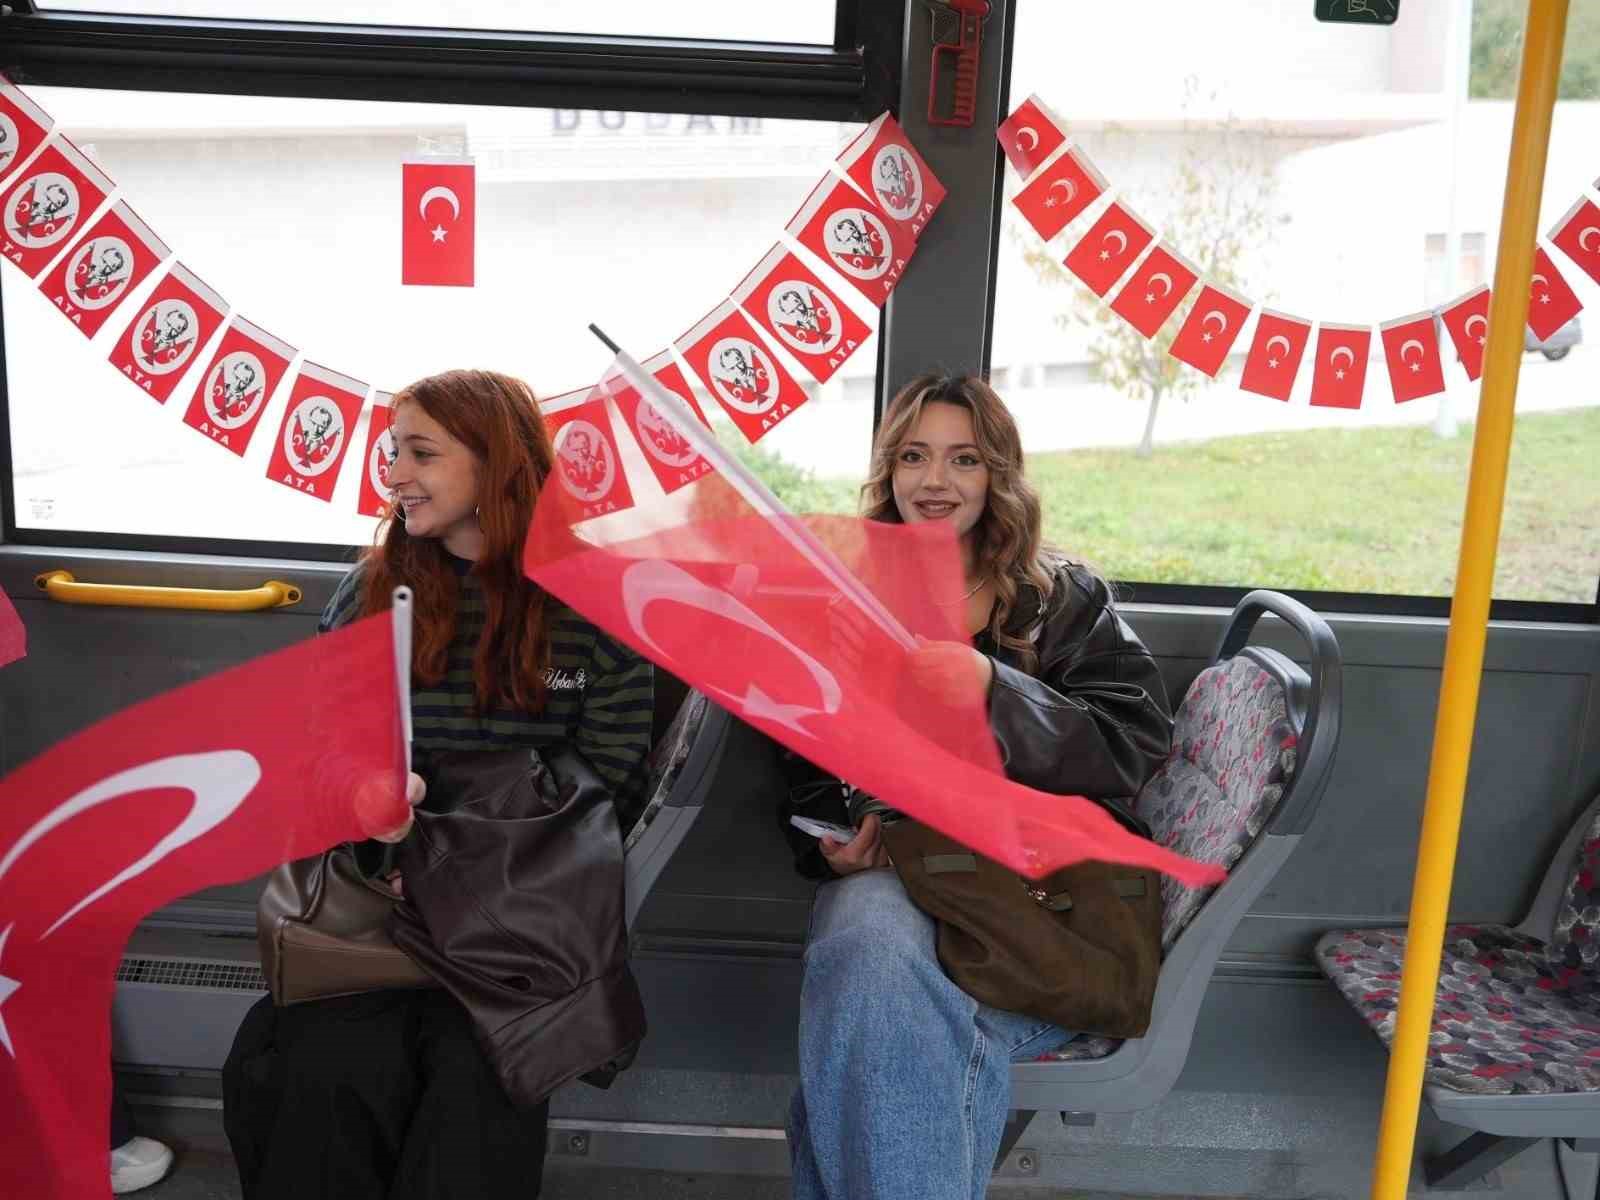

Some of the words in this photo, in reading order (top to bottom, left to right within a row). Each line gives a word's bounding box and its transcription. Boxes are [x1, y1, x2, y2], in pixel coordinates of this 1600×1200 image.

[912, 203, 934, 234] ATA
[0, 236, 23, 263] TA
[883, 259, 905, 291] ATA
[53, 295, 83, 324] ATA
[829, 339, 858, 369] ATA
[123, 364, 153, 390] ATA
[762, 403, 791, 430] ATA
[200, 422, 230, 446] ATA
[283, 474, 316, 493] ATA
[680, 460, 711, 483] ATA
